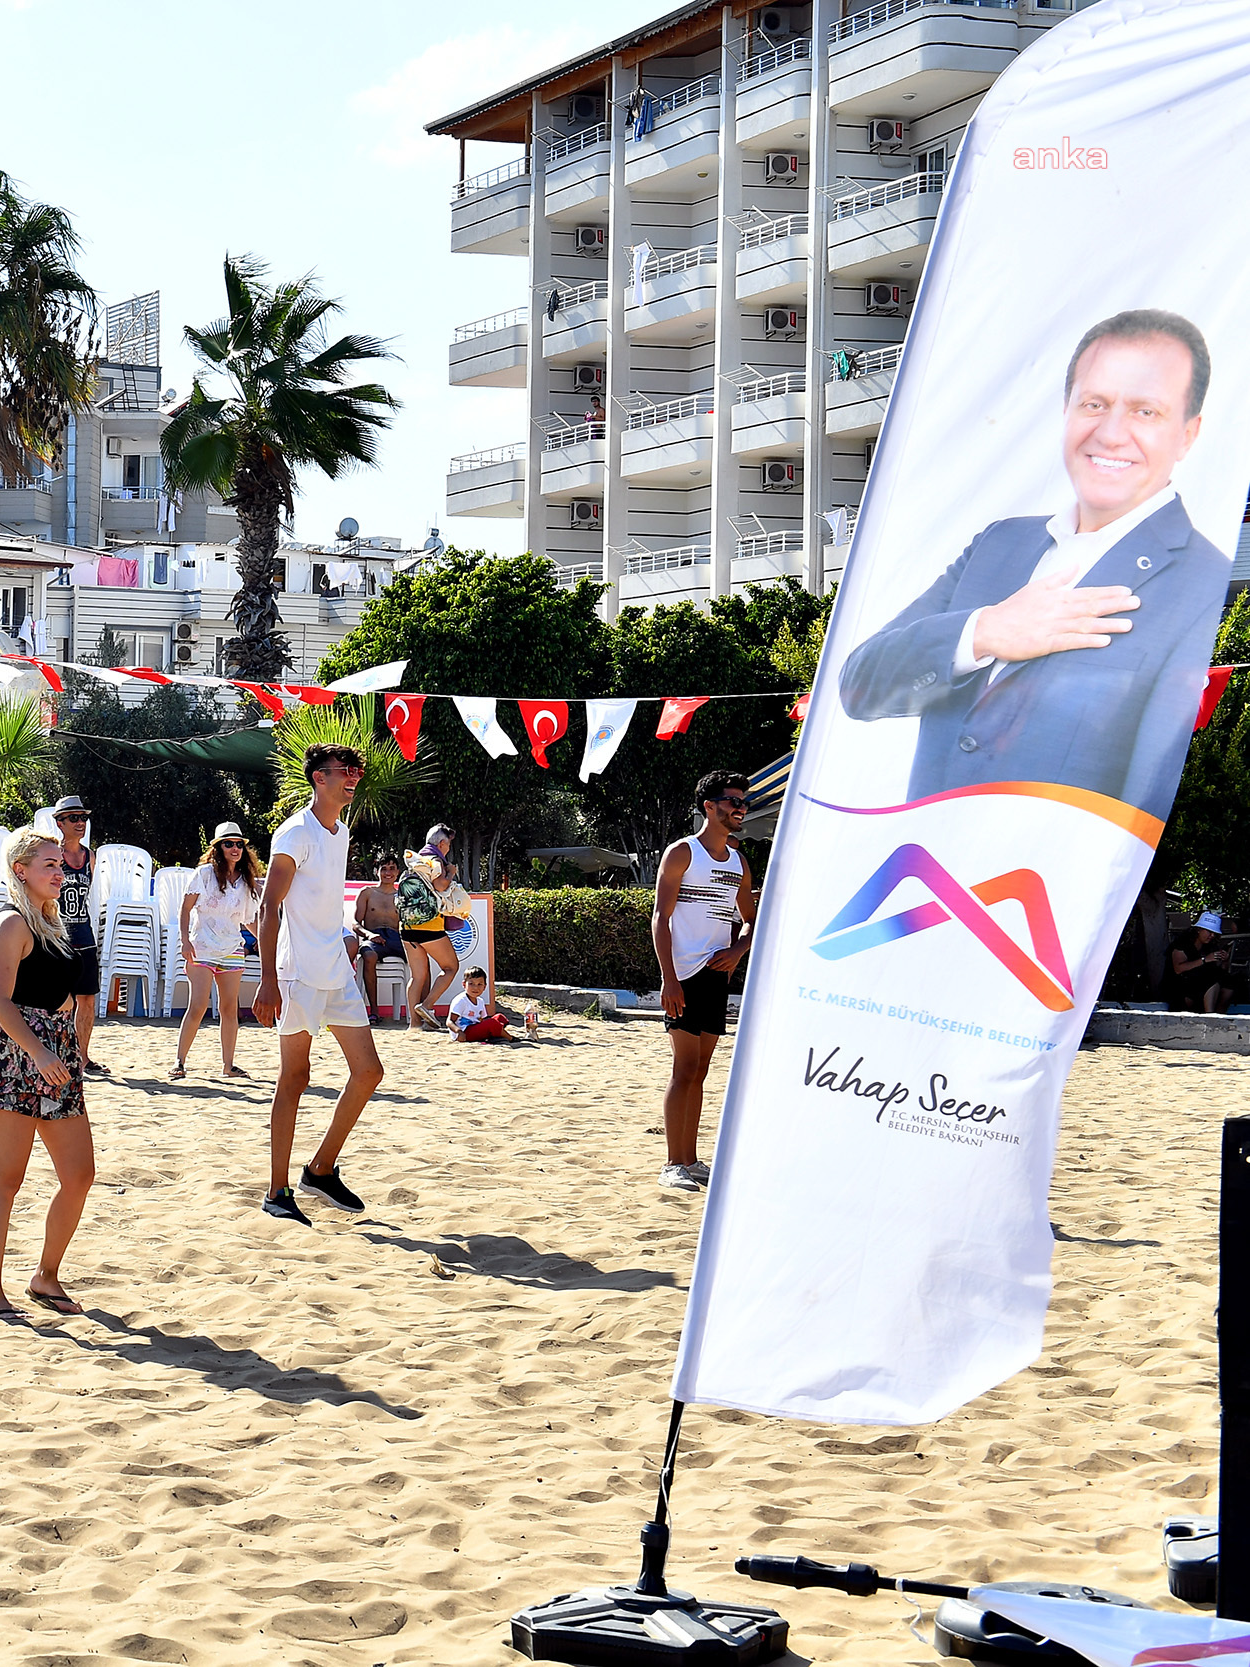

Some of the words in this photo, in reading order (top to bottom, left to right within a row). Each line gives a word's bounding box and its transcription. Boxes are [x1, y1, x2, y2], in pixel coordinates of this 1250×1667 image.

[65, 887, 88, 917] 87
[798, 986, 821, 1002] T.C.
[826, 993, 883, 1015] MERSİN
[888, 1004, 983, 1038] BÜYÜKŞEHİR
[804, 1046, 909, 1124] Vahap
[918, 1073, 1006, 1125] Seçer
[888, 1120, 936, 1138] BELEDİYE
[938, 1130, 983, 1148] BAŞKANI
[890, 1109, 909, 1121] T.C.
[910, 1114, 952, 1130] MERSİN
[954, 1123, 1021, 1146] BÜYÜKŞEHİR
